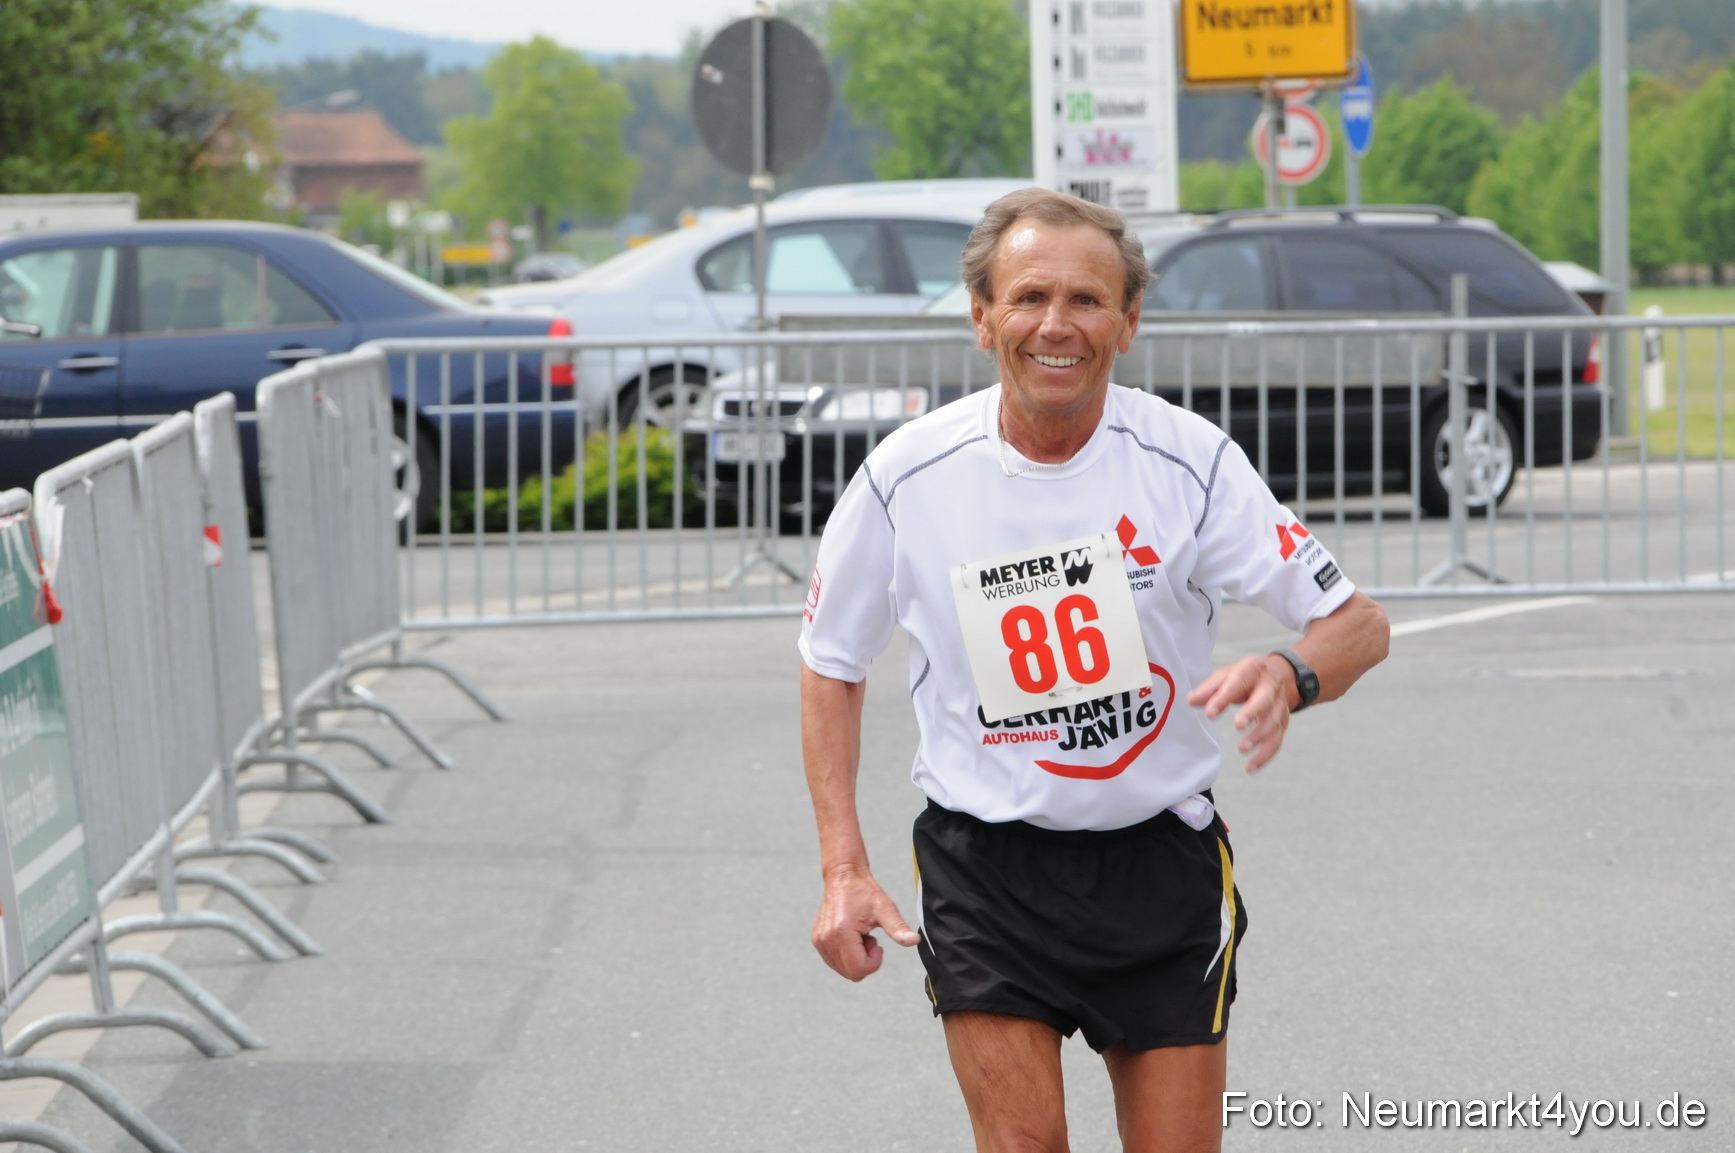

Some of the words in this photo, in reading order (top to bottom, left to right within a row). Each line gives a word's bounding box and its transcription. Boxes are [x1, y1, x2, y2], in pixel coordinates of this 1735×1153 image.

[1197, 0, 1333, 31] Neumarkt
[979, 555, 1057, 588] MEYER
[982, 574, 1061, 601] WERBUNG
[1000, 593, 1111, 695] 86
[982, 729, 1060, 746] AUTOHAUS
[1058, 700, 1157, 751] JÄNIG
